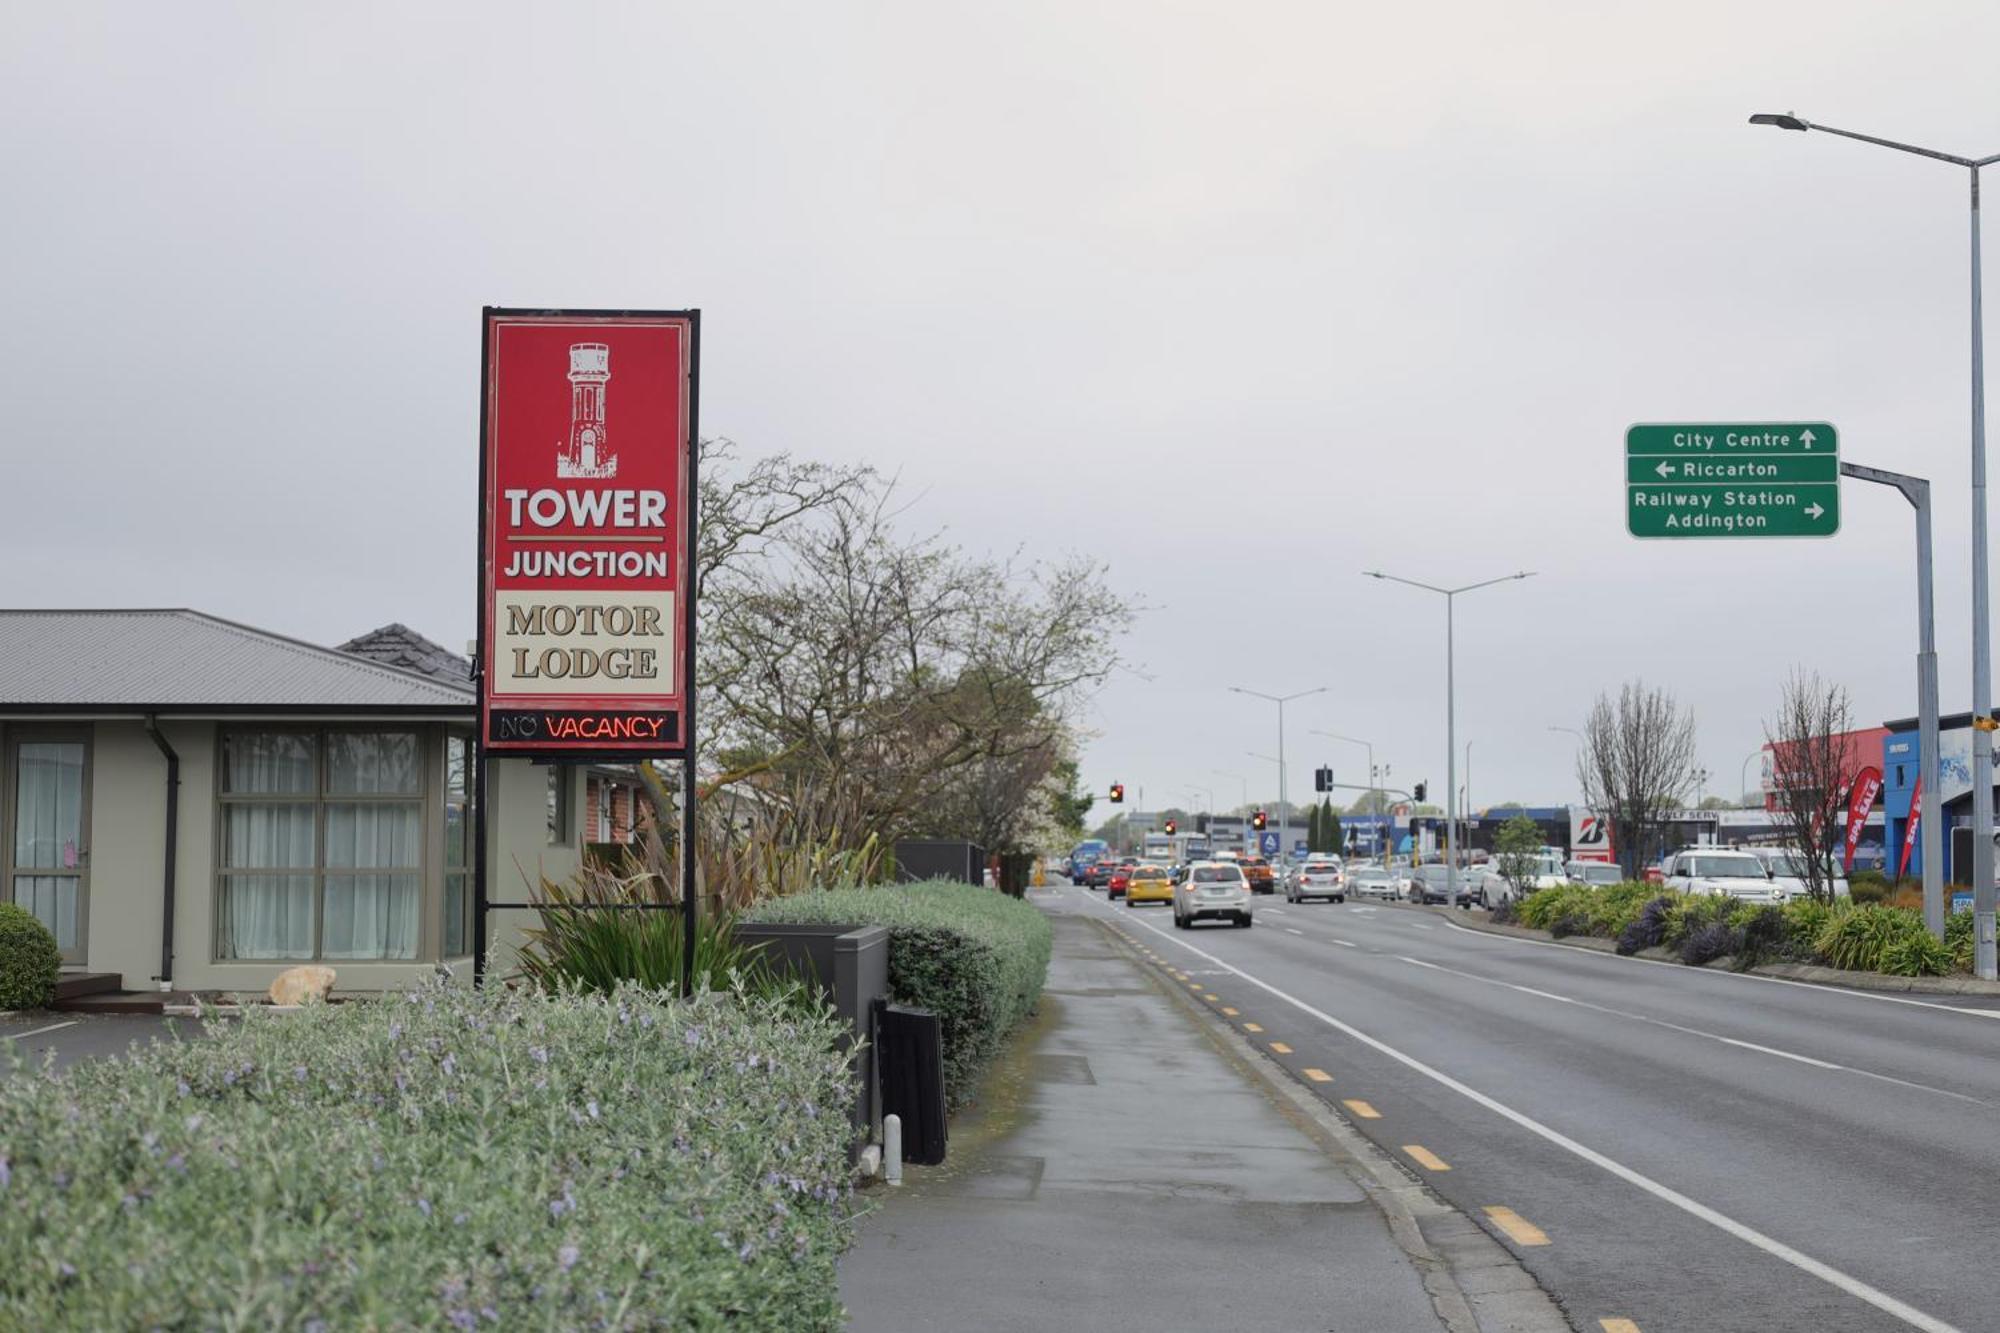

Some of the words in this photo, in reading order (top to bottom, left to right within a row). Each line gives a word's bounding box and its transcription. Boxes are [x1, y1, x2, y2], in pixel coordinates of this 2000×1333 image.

[1673, 432, 1715, 450] City
[1726, 432, 1790, 446] Centre
[1683, 461, 1778, 476] Riccarton
[504, 488, 667, 529] TOWER
[1634, 491, 1712, 509] Railway
[1723, 491, 1796, 506] Station
[1665, 512, 1767, 531] Addington
[504, 549, 668, 578] JUNCTION
[506, 603, 664, 637] MOTOR
[511, 646, 658, 680] LODGE
[499, 714, 538, 740] NO
[544, 714, 667, 740] VACANCY
[1848, 819, 1865, 845] SPA
[1859, 779, 1880, 817] SALE
